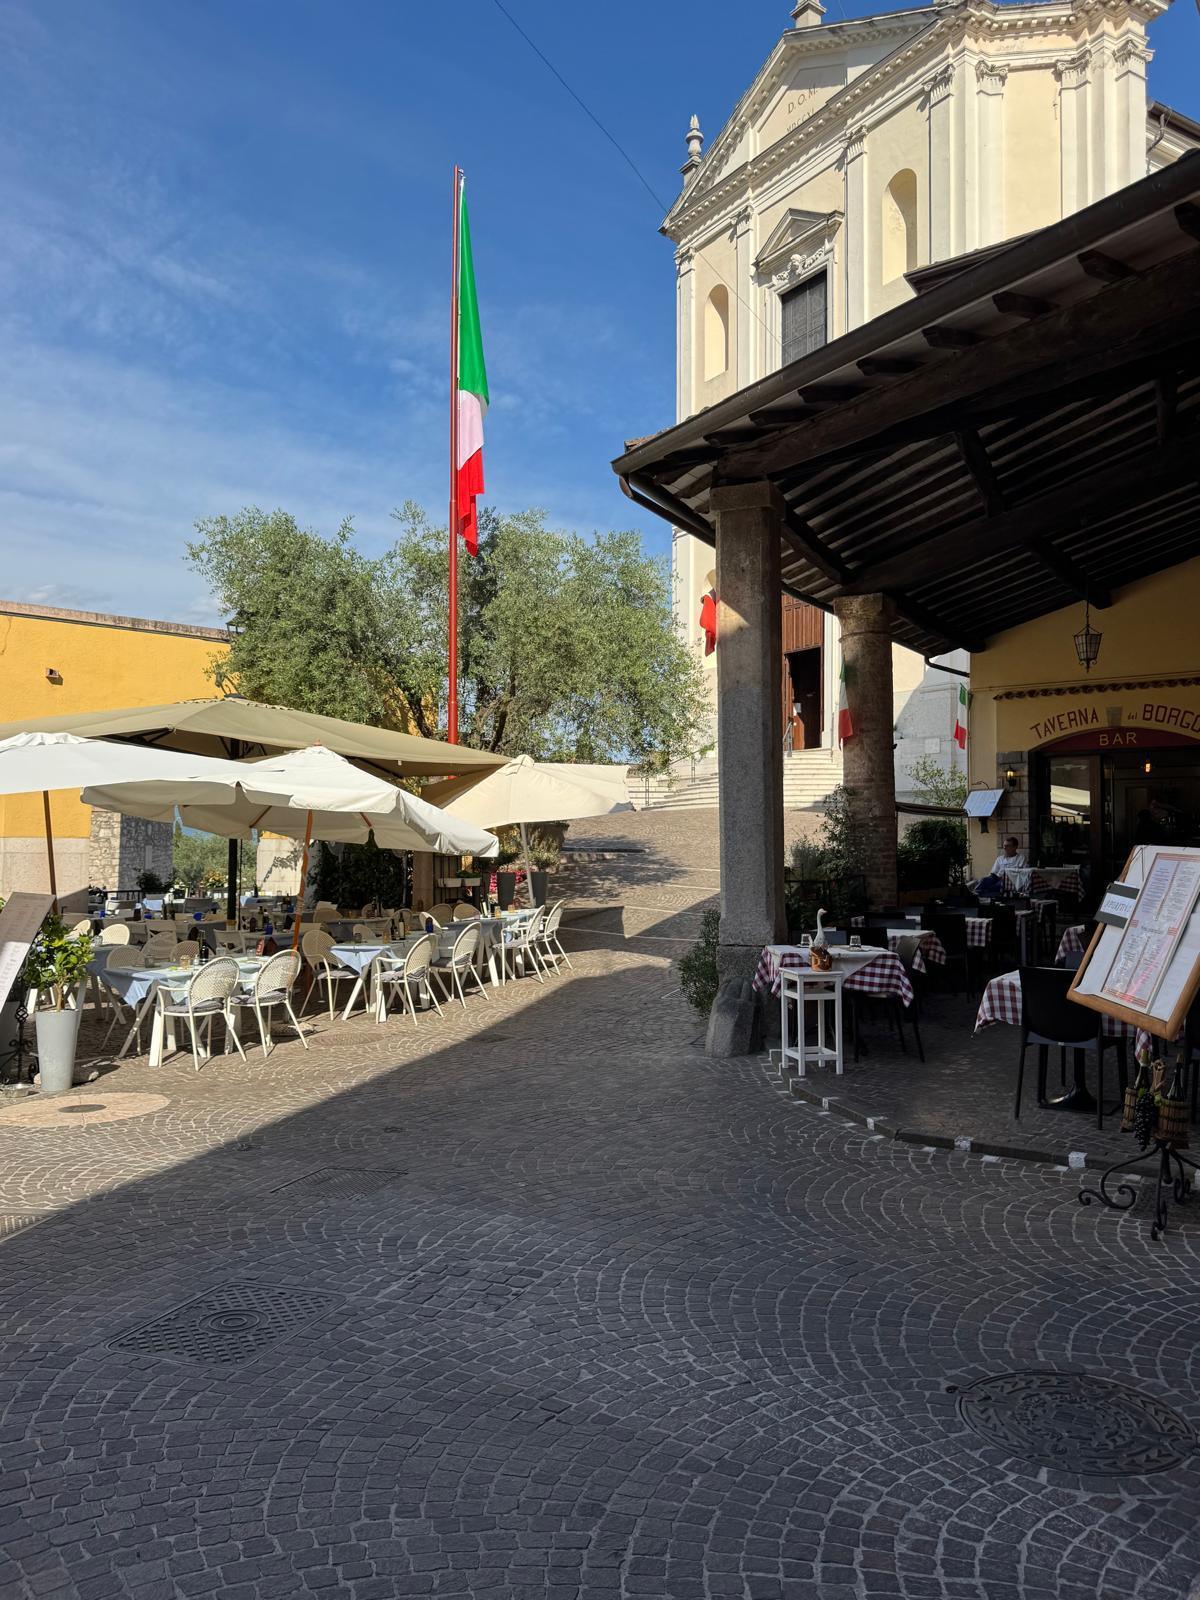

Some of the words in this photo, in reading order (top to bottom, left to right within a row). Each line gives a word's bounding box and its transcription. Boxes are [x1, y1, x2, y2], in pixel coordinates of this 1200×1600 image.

[1030, 707, 1099, 740] TAVERNA
[1127, 711, 1138, 721] del
[1100, 732, 1137, 746] BAR
